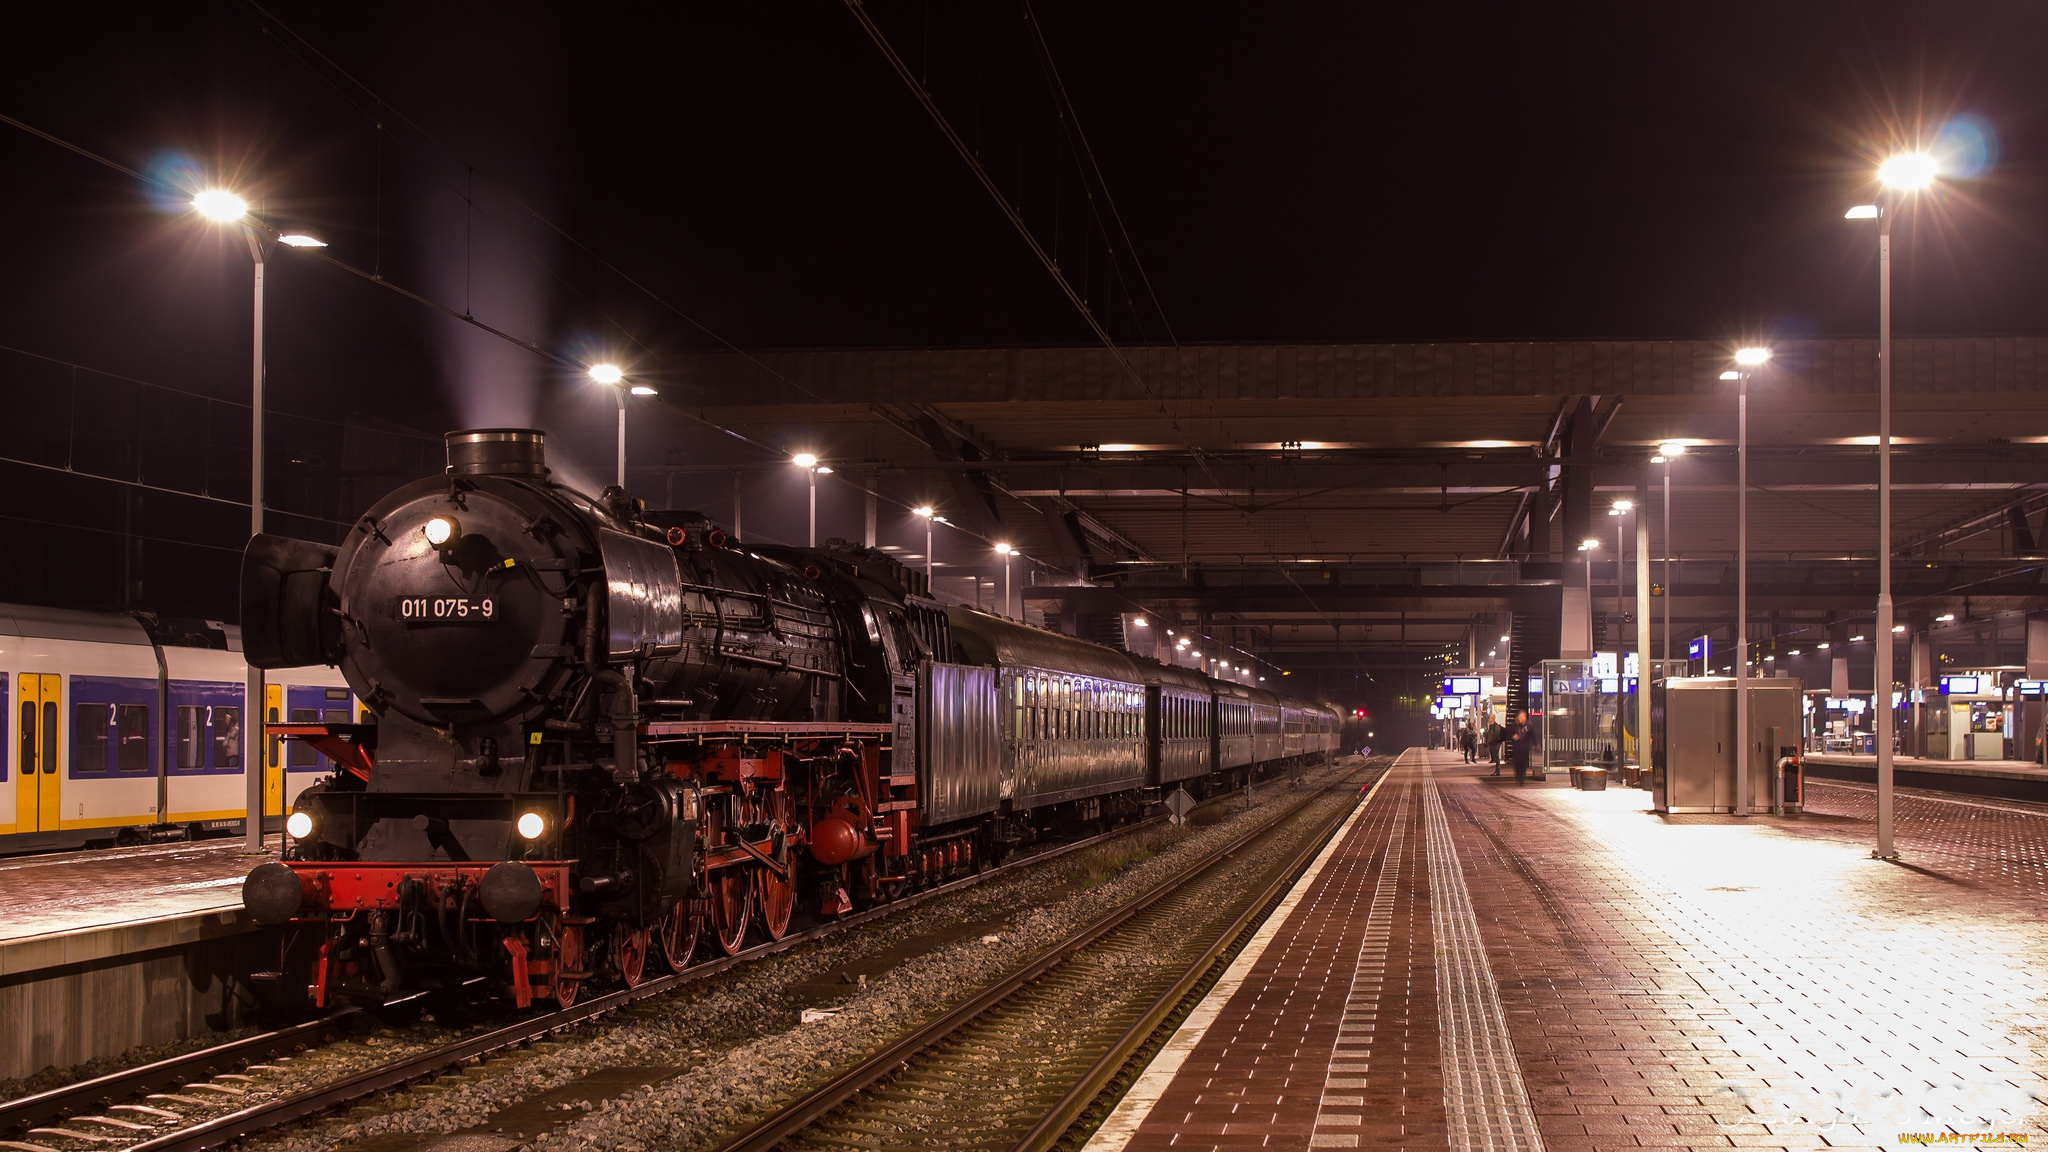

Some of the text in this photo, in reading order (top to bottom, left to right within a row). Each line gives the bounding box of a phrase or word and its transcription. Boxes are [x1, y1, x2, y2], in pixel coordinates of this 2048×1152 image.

[402, 599, 493, 617] 011 075-9
[110, 703, 117, 726] 2
[206, 705, 213, 727] 2
